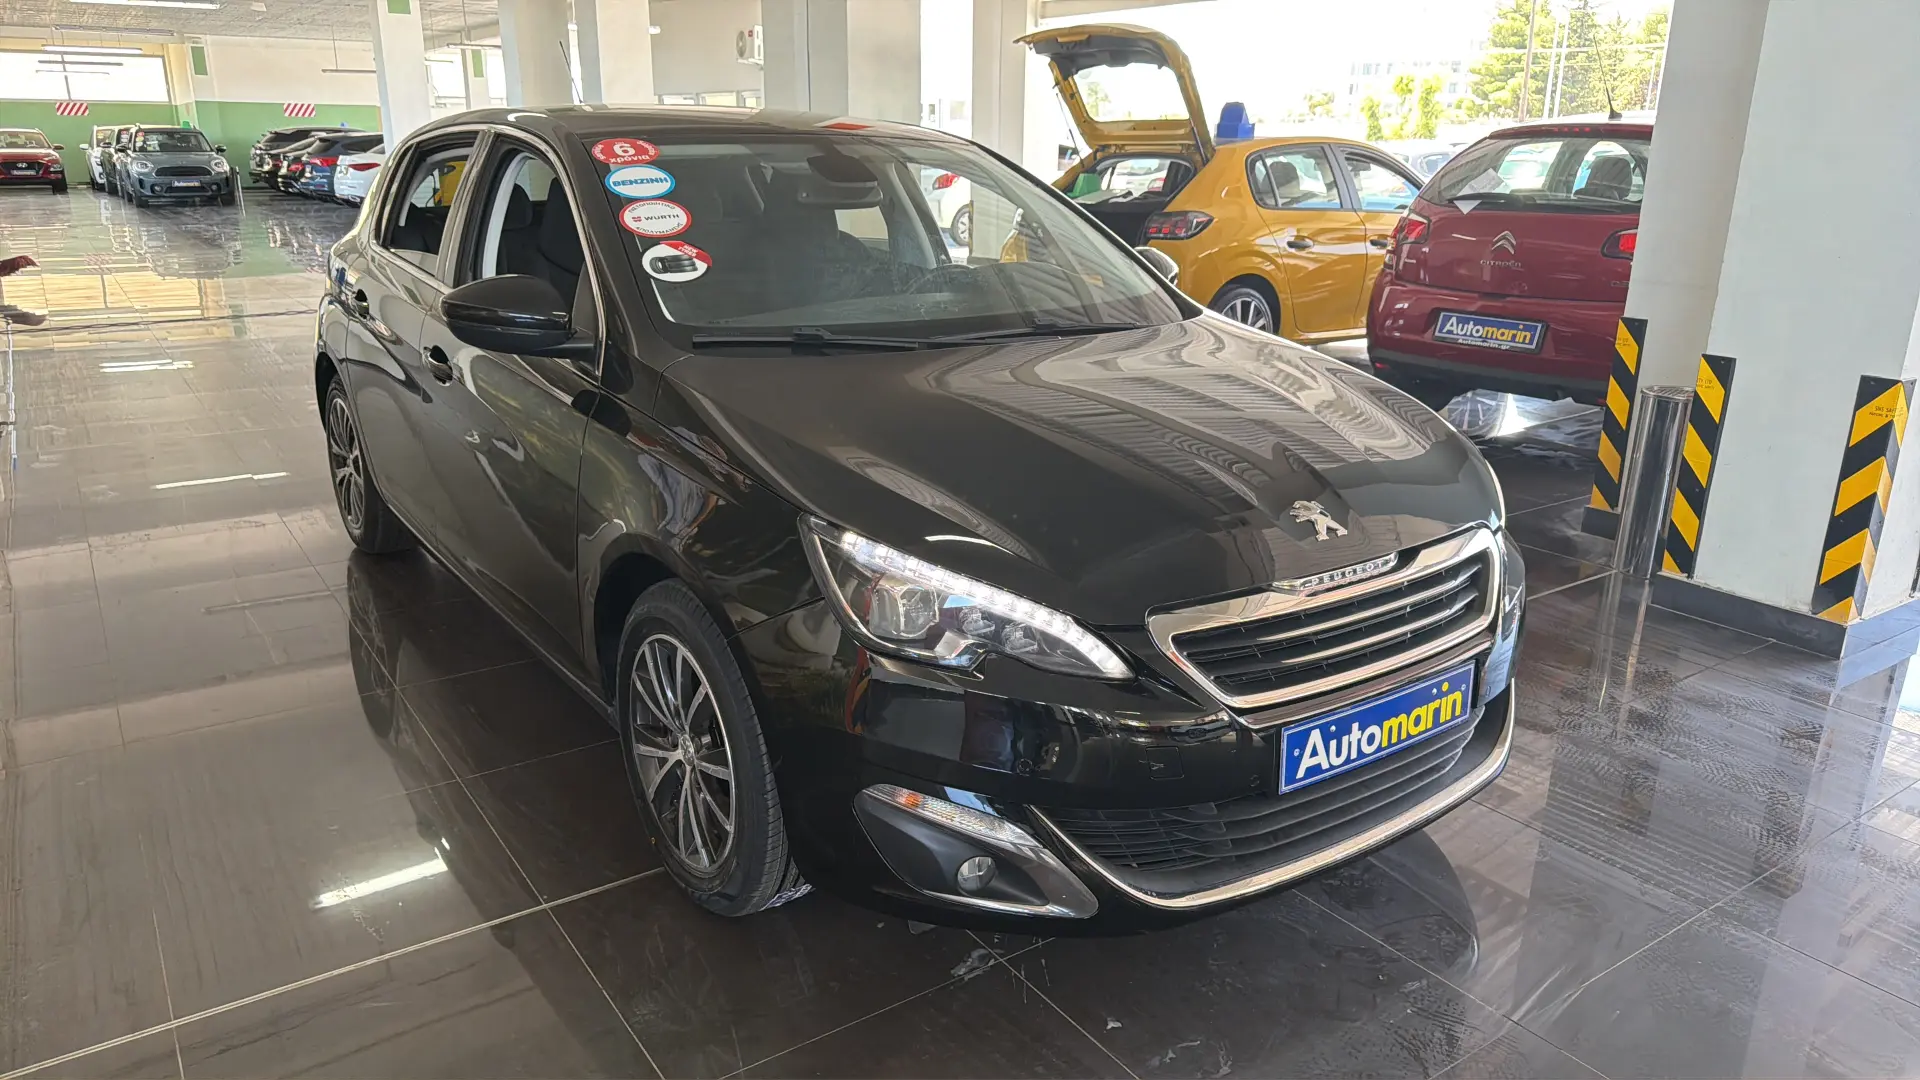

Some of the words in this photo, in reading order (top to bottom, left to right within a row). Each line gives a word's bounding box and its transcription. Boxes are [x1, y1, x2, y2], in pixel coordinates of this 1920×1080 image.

[609, 154, 650, 164] χρόνια
[613, 143, 636, 156] 6
[1442, 316, 1531, 343] Automarin
[1457, 338, 1511, 350] Automarin.gr
[1311, 561, 1384, 586] PEUGEOT
[1295, 681, 1463, 779] Automarin
